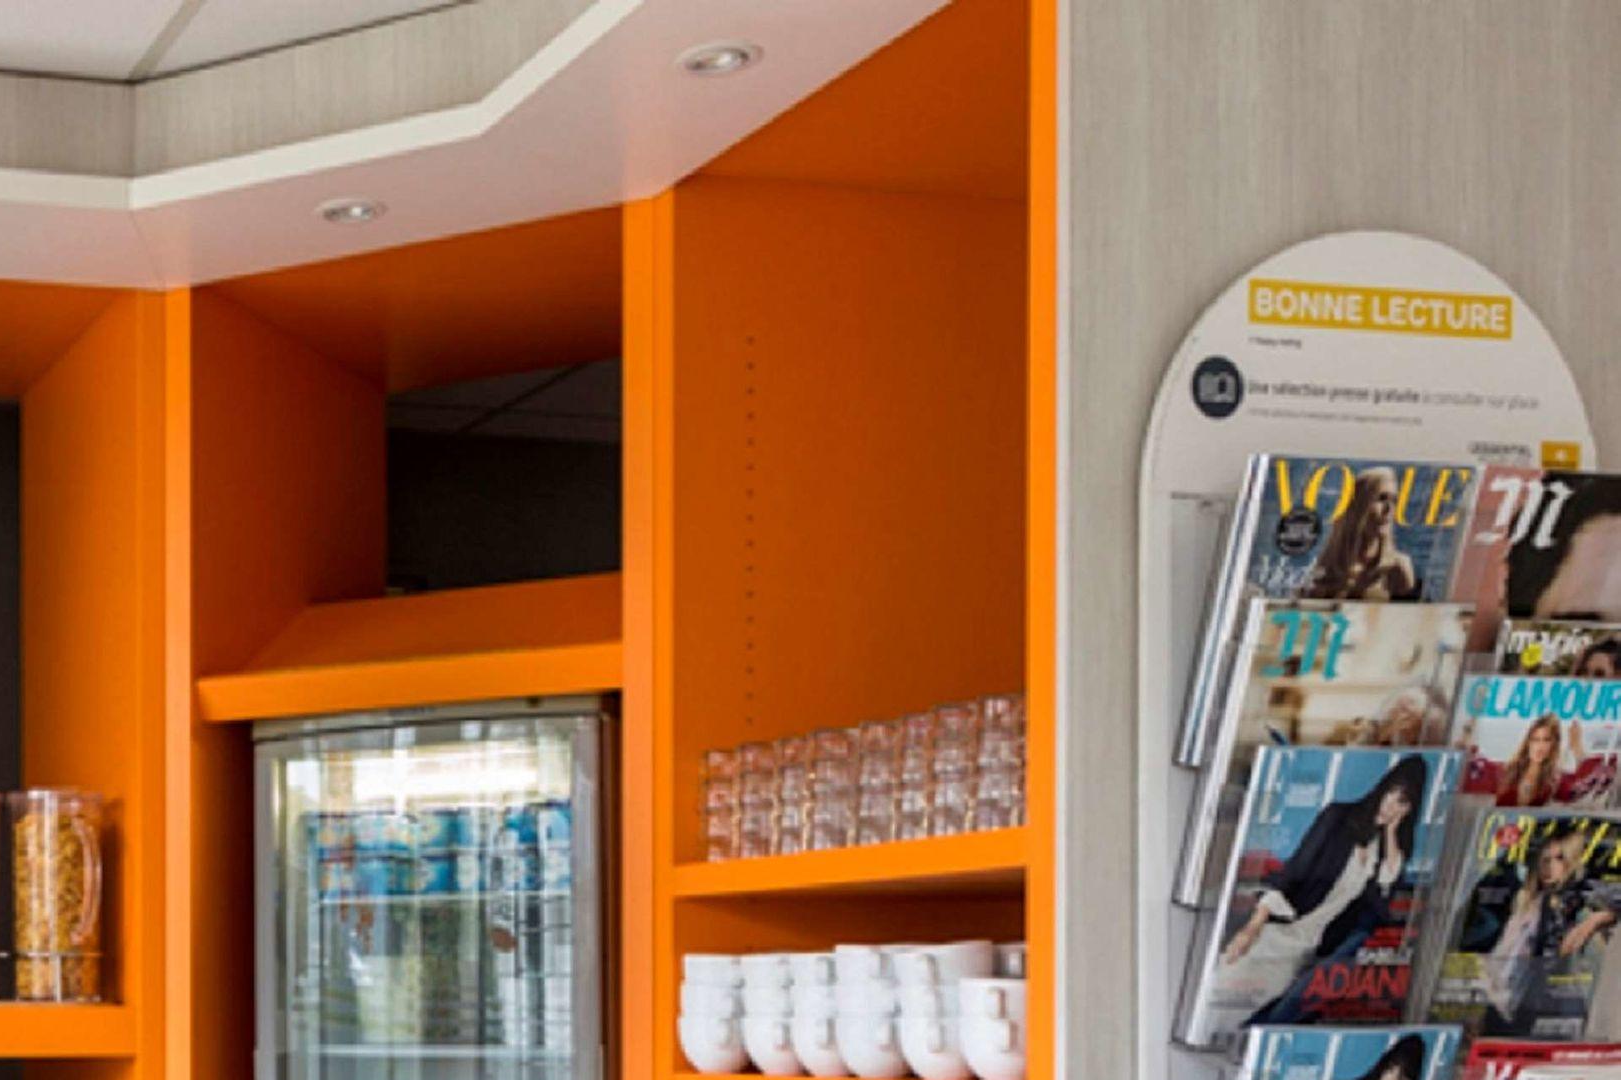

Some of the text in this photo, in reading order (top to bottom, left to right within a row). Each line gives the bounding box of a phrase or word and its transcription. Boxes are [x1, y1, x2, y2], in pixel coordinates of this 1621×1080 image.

[1255, 287, 1508, 333] BONNE LECTURE
[1276, 459, 1472, 527] VOUE
[1466, 675, 1621, 721] GLAMOUR
[1258, 750, 1461, 825] ELE
